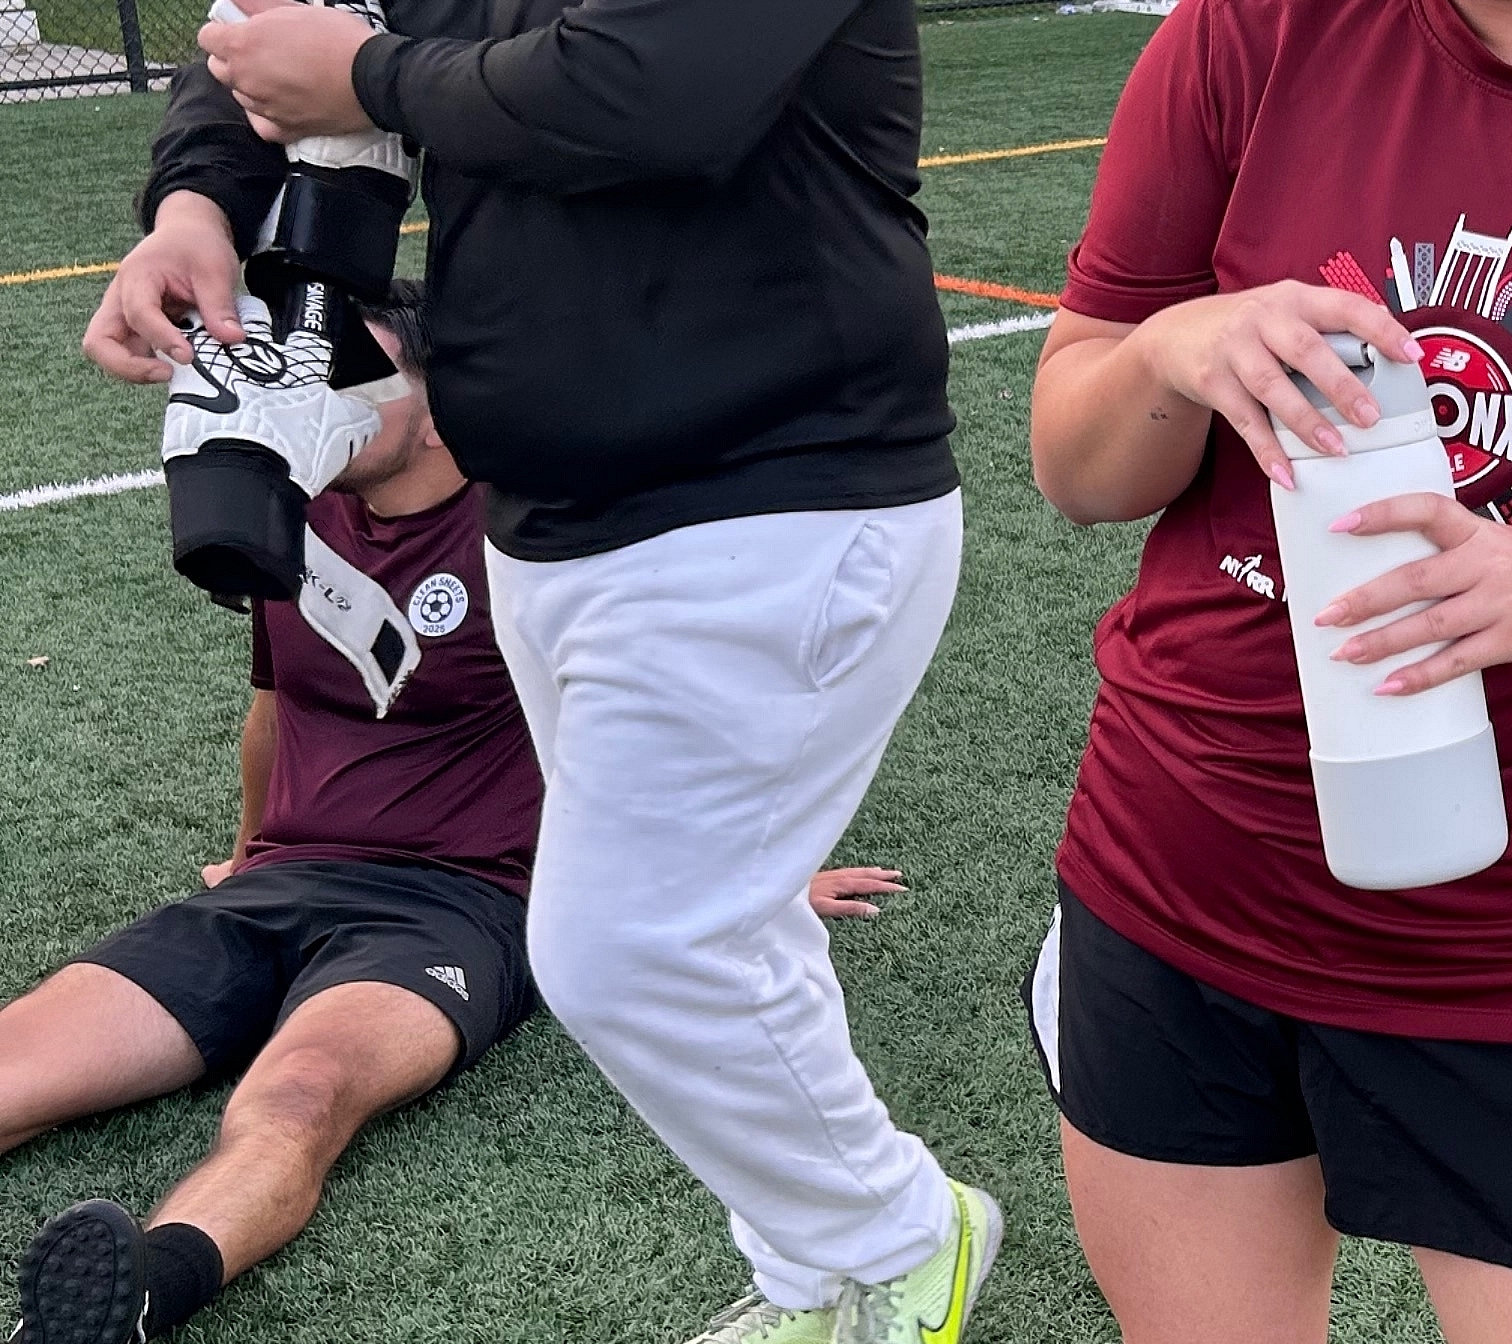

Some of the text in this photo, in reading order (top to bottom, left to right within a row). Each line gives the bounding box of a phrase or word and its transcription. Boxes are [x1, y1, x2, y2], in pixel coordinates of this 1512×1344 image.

[304, 282, 325, 332] SAVAGE
[413, 576, 465, 606] CLEAN SHEETS
[422, 624, 446, 634] 2025
[424, 967, 469, 1001] adidas
